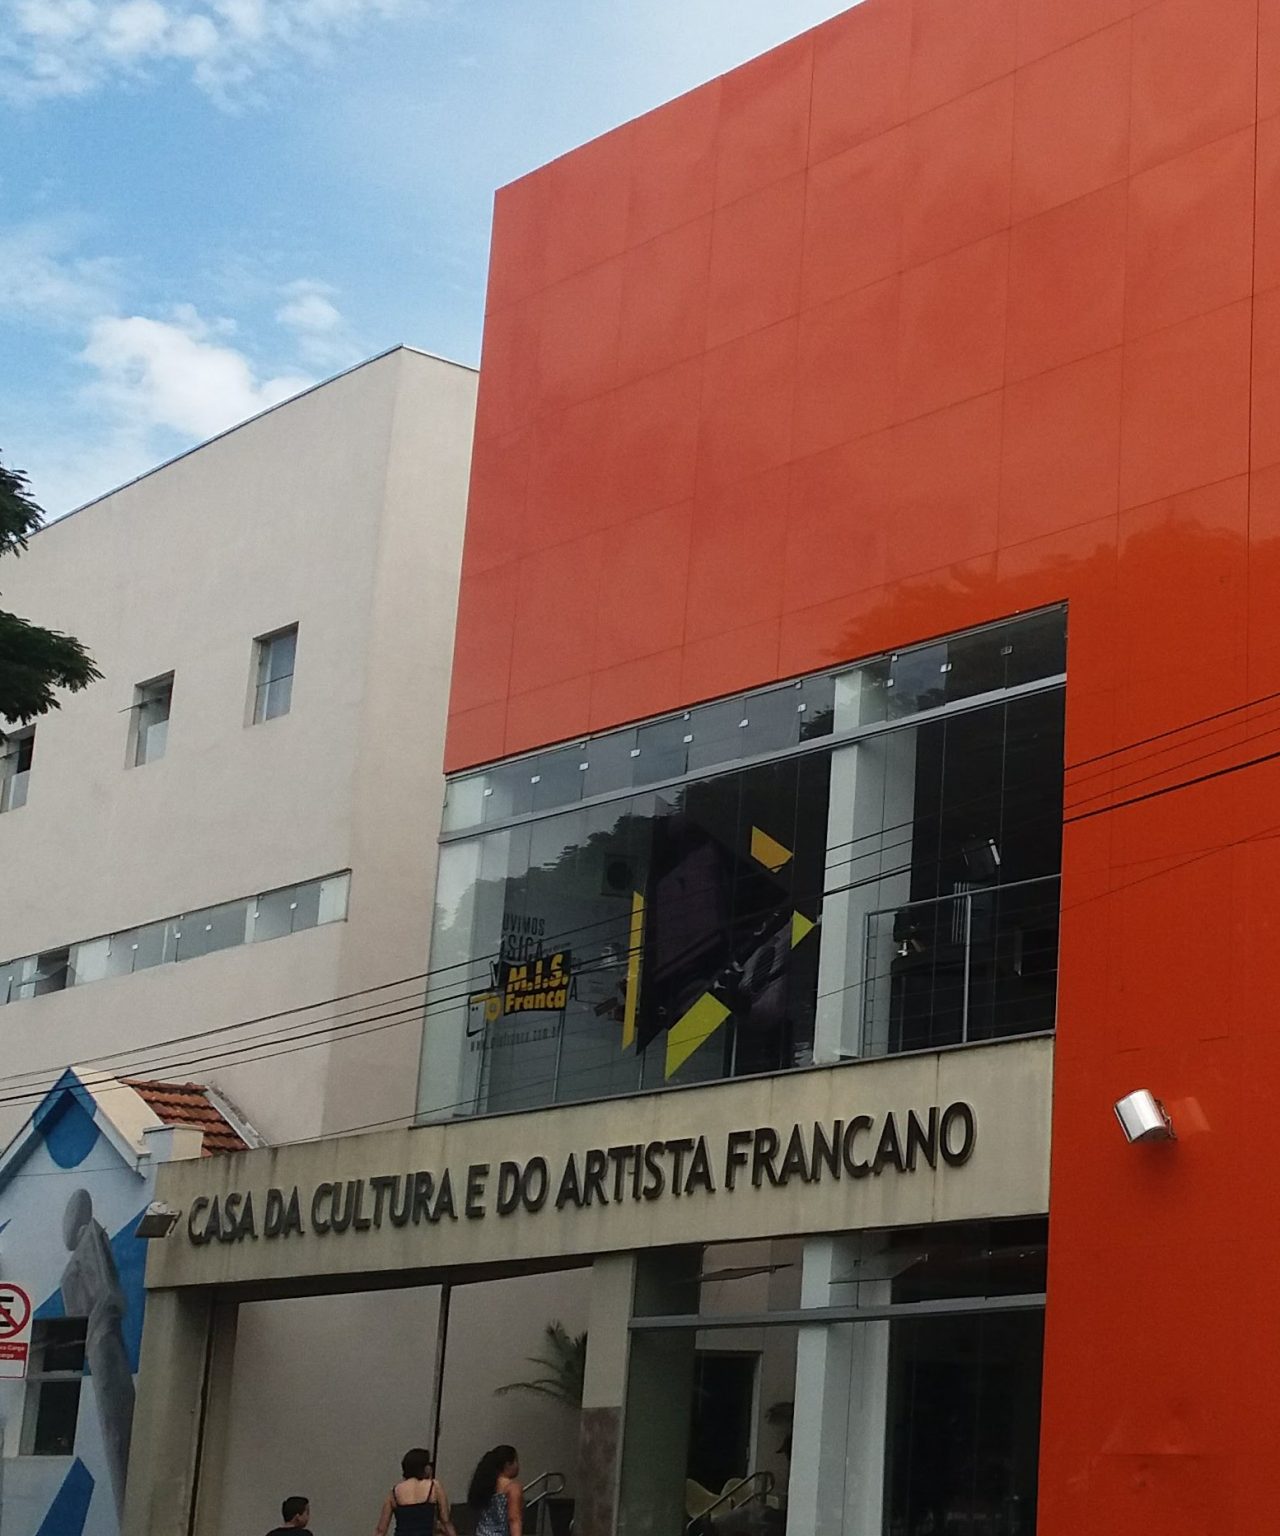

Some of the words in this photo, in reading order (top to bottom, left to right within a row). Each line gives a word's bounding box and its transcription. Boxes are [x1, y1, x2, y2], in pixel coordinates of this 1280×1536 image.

[505, 989, 566, 1012] Franca
[188, 1190, 258, 1245] CASA
[264, 1186, 304, 1238] DA
[311, 1168, 458, 1235] CULTURA
[465, 1164, 490, 1218] E
[497, 1156, 549, 1215] DO
[555, 1135, 716, 1208] ARTISTA
[725, 1102, 978, 1189] FRANCANO
